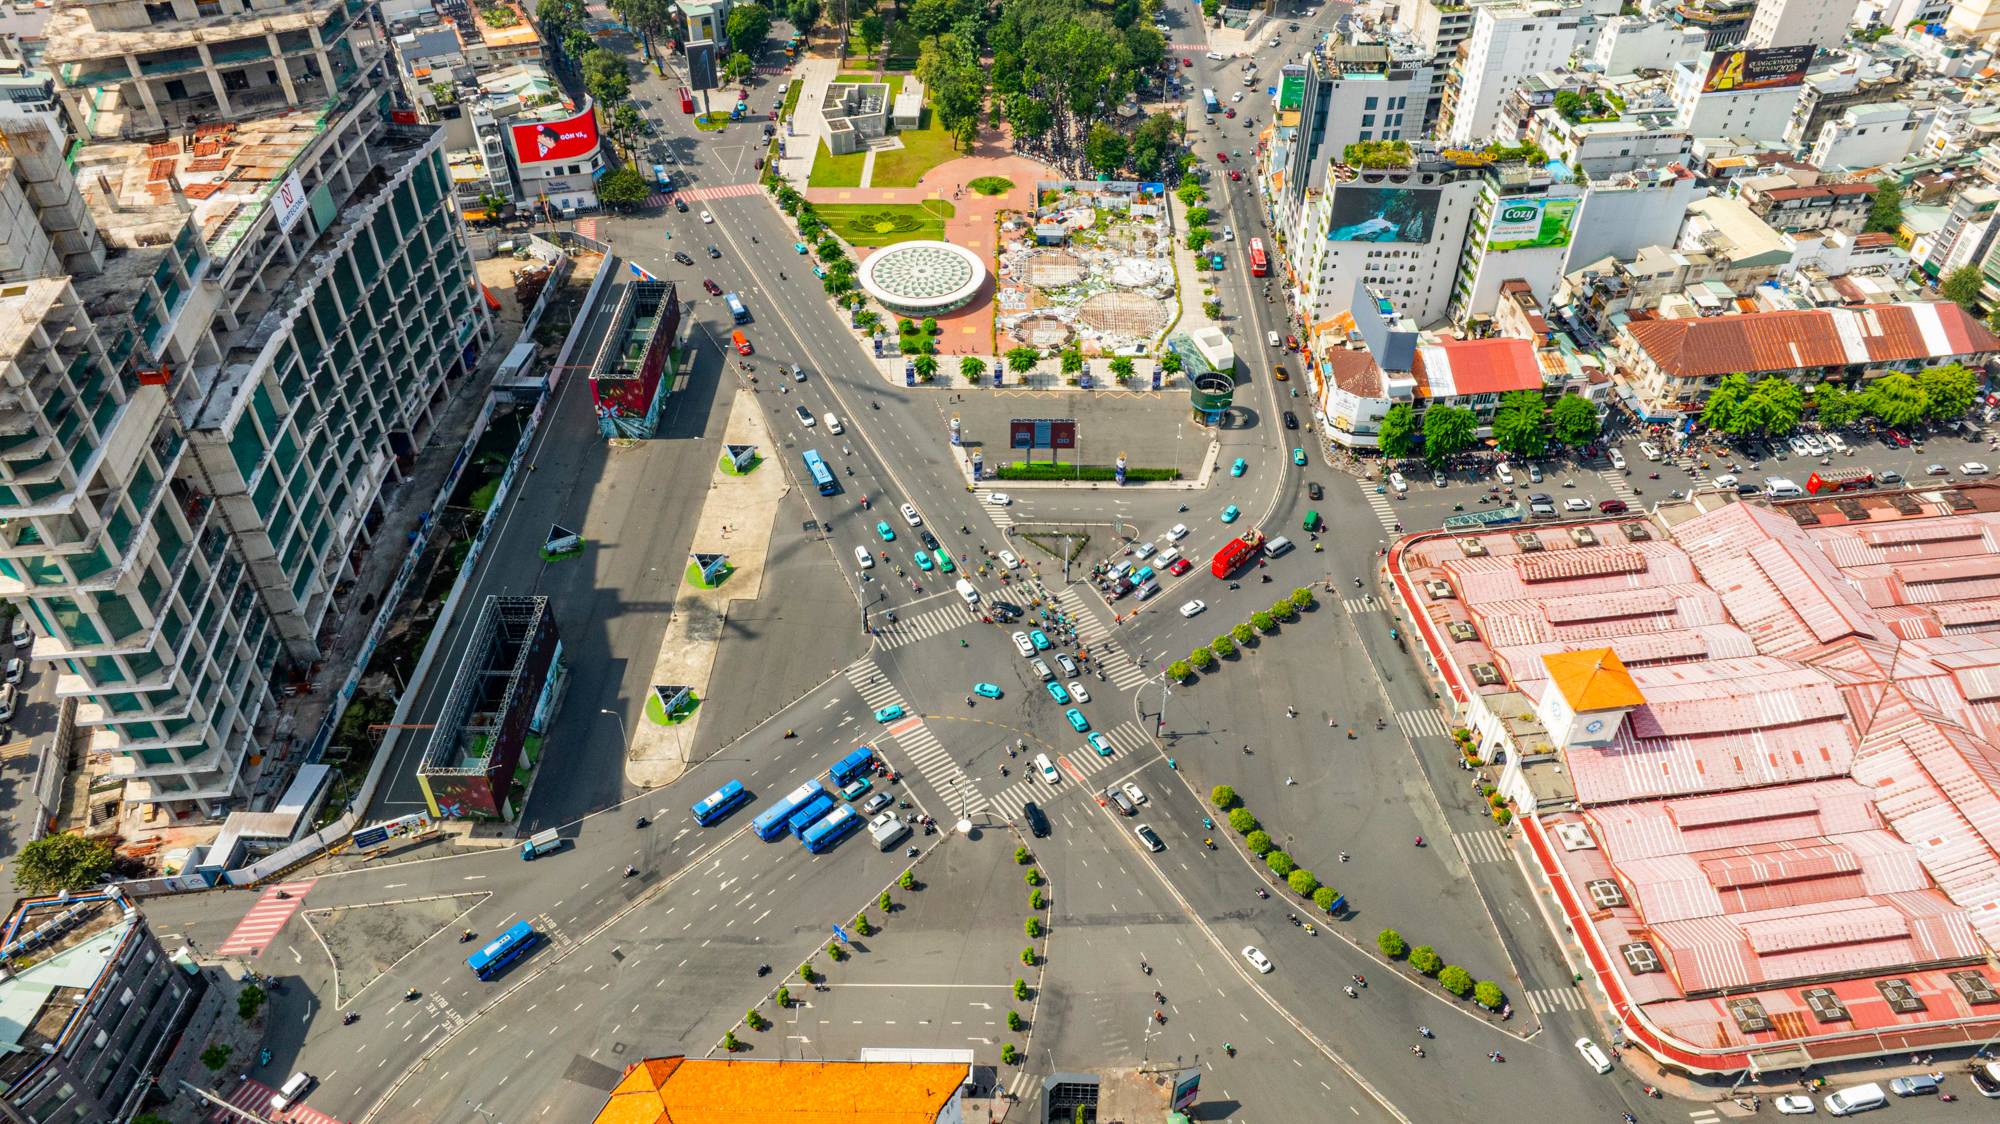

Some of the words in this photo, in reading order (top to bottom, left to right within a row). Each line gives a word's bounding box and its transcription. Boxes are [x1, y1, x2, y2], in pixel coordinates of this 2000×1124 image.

[1401, 60, 1423, 69] hotel
[1777, 62, 1798, 73] 2025
[1443, 149, 1498, 161] NEVERLAND
[280, 195, 305, 229] NEWTECONS
[1505, 208, 1535, 220] Cozy
[539, 912, 557, 930] BUÝT
[536, 923, 548, 934] XE
[553, 928, 572, 946] BUÝT
[550, 940, 562, 952] XE
[430, 991, 449, 1009] BUÝT
[425, 1002, 438, 1015] XE
[441, 1019, 455, 1032] XE
